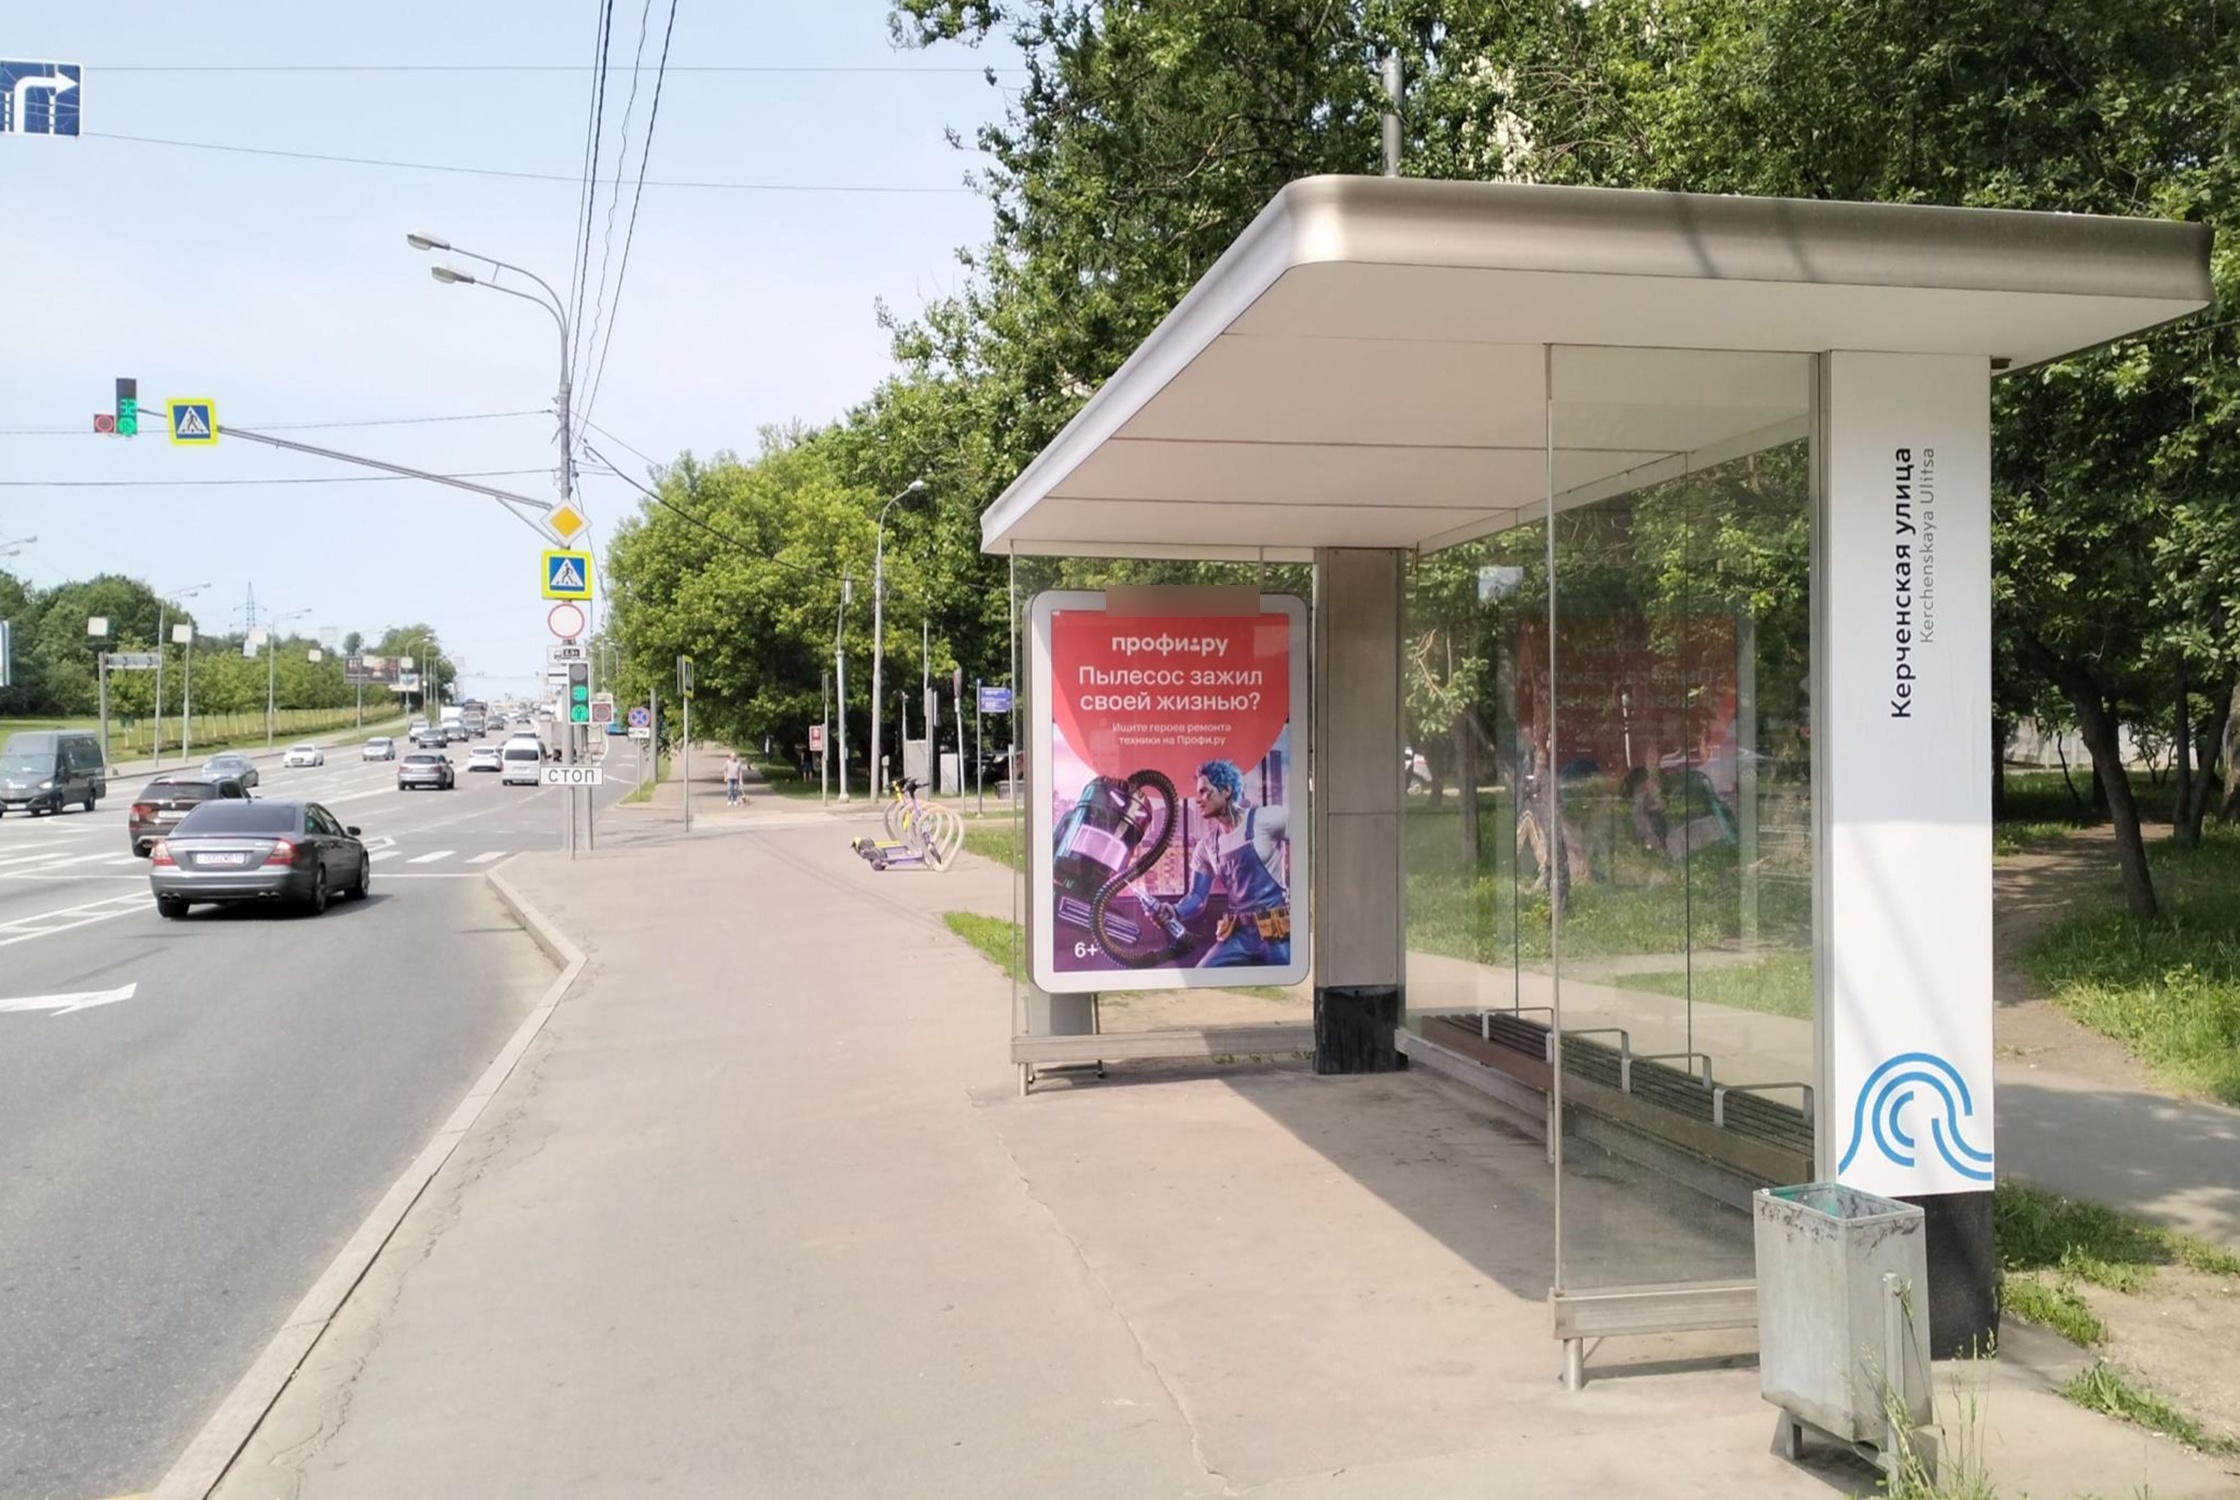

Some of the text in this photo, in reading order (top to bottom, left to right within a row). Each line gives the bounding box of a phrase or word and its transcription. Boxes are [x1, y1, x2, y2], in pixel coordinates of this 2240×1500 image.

[1919, 448, 1936, 643] Kerchenskaya Ulitsa
[1891, 448, 1916, 718] Керченская улица
[1079, 667, 1263, 685] Пылесос зажил
[1080, 691, 1261, 710] своей жизнью?
[1112, 723, 1231, 734] Ищите героев ремонта
[1119, 736, 1226, 747] техники на Профи.ру
[549, 769, 595, 783] СТОП
[1075, 942, 1098, 958] 6+
